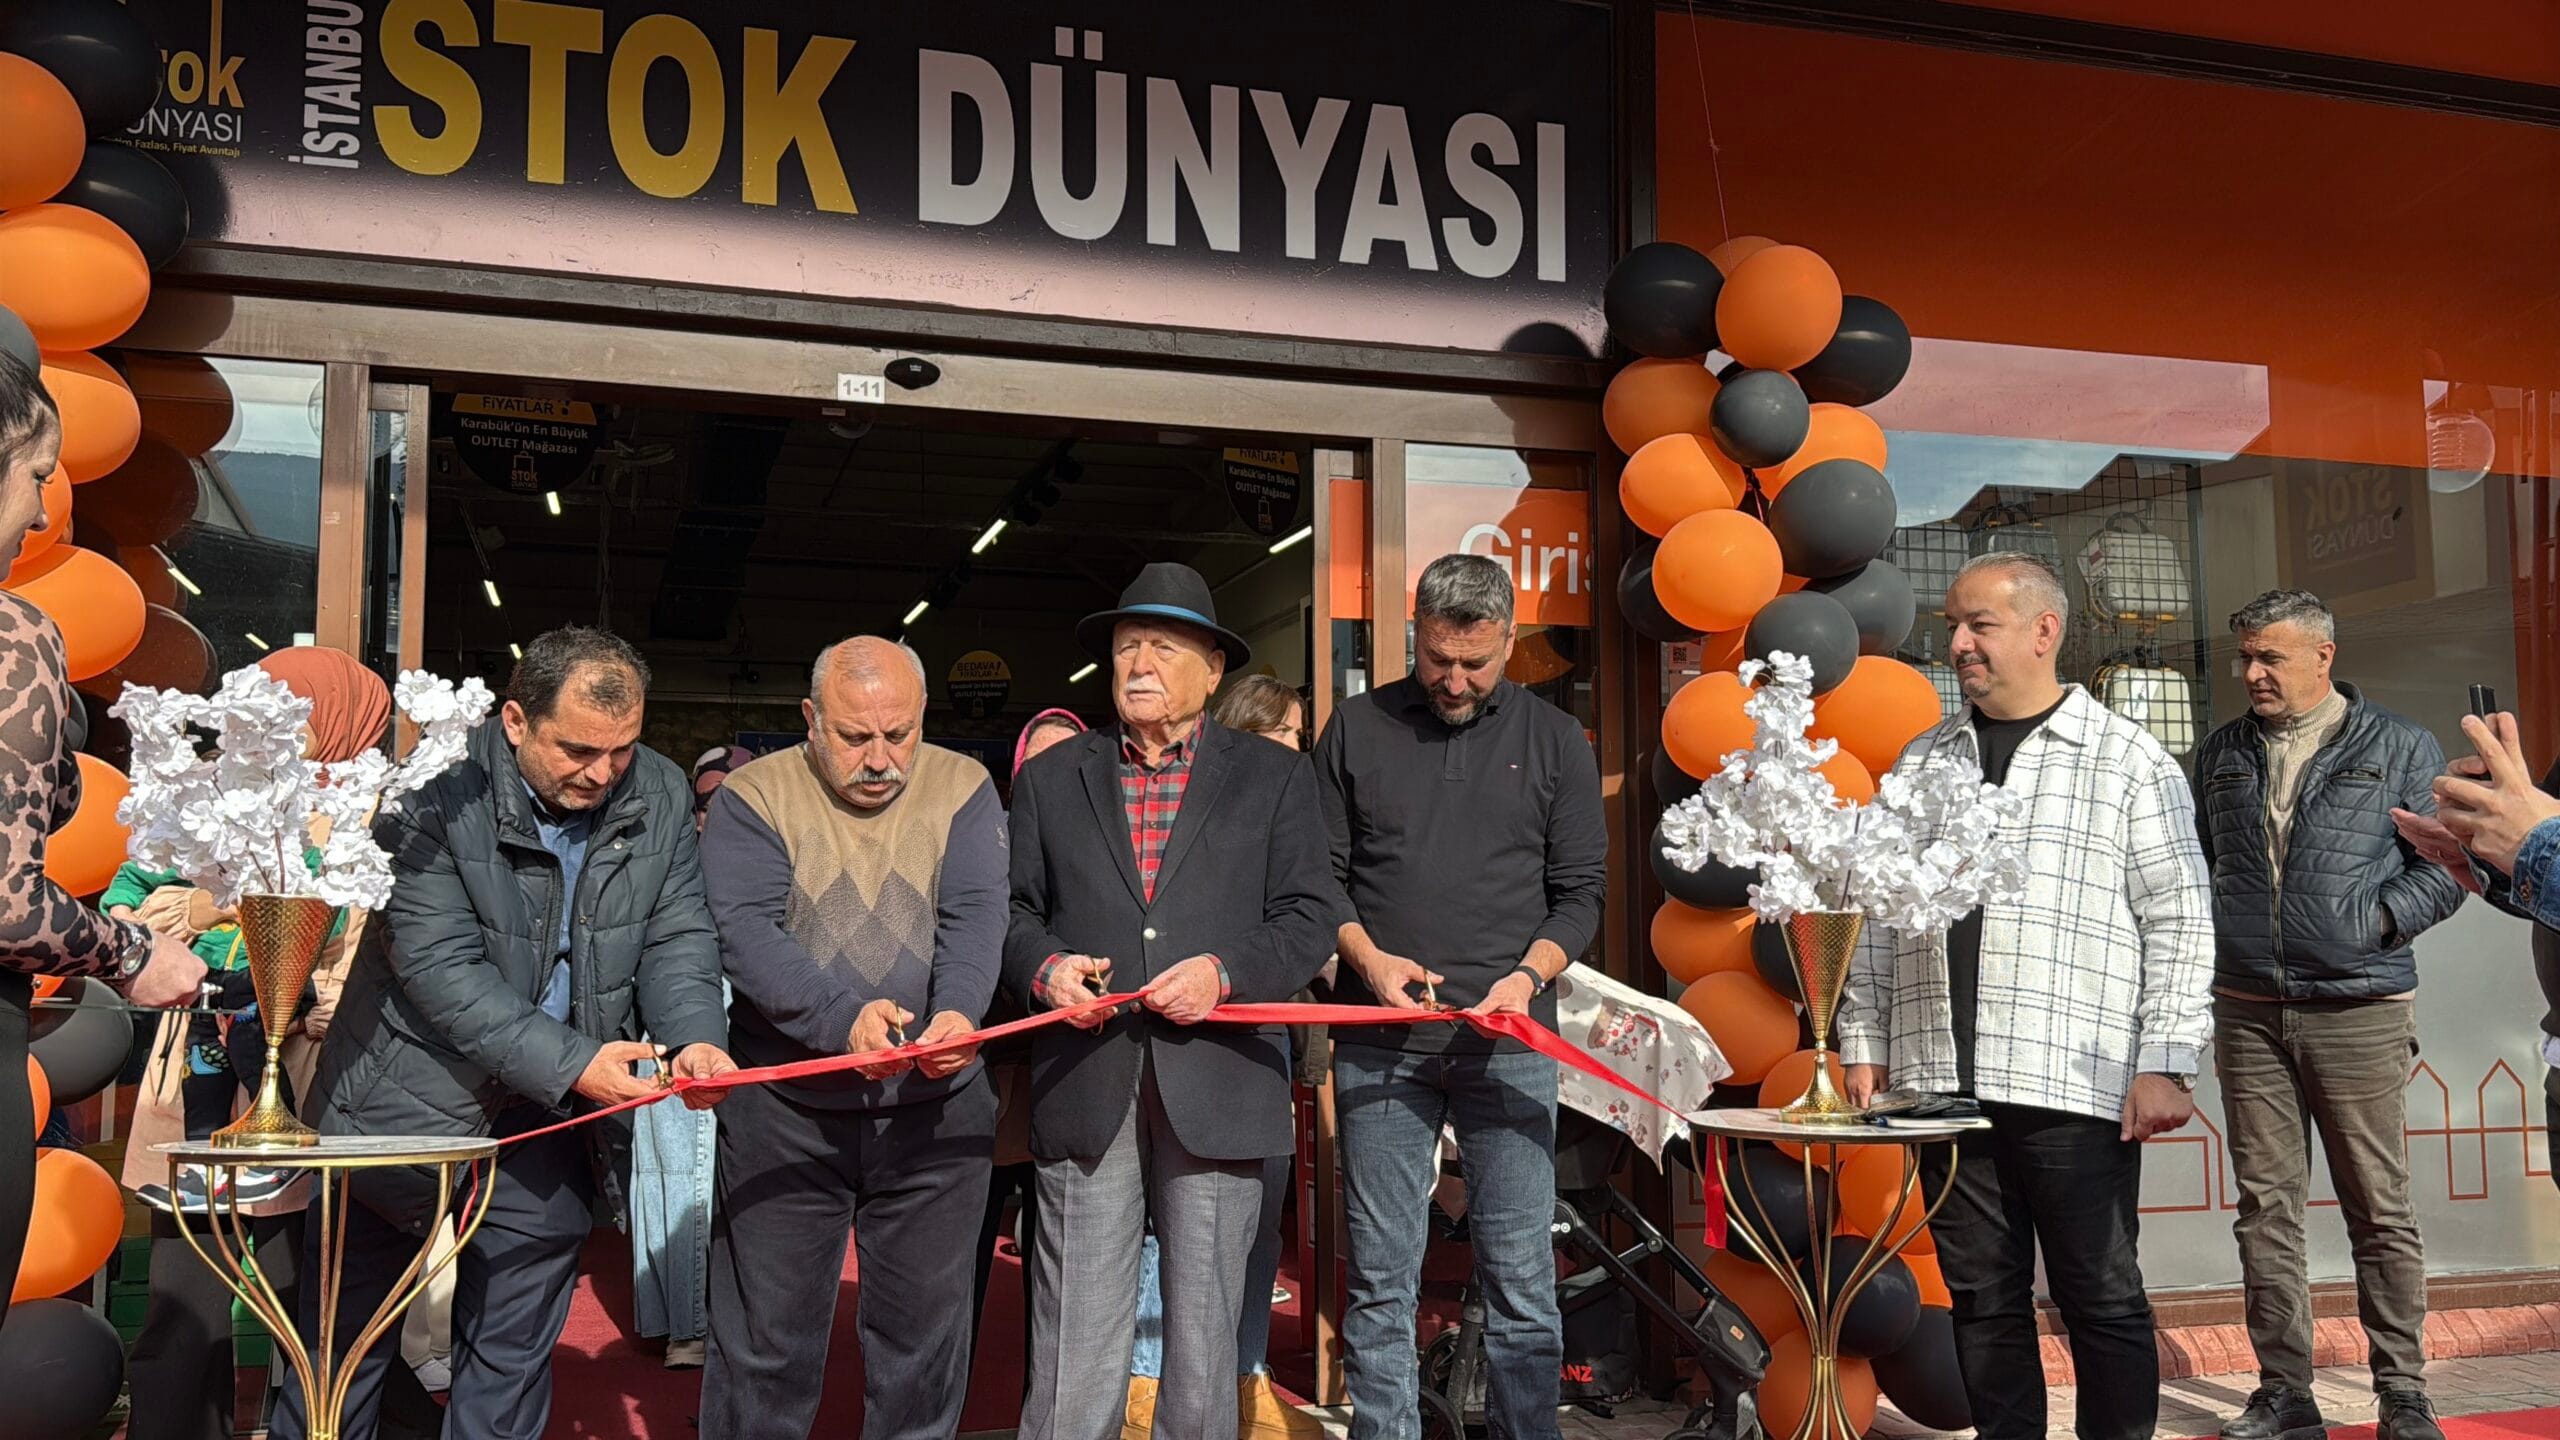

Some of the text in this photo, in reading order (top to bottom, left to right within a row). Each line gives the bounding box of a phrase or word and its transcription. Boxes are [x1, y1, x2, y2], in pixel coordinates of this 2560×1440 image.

[160, 49, 247, 109] OK
[173, 142, 197, 155] Fiyat
[199, 144, 241, 158] Avantajı
[372, 0, 1566, 282] STOK DÜNYASI
[842, 379, 880, 398] 1-11
[461, 417, 589, 440] Karabük'ün En Büyük
[471, 435, 577, 455] OUTLET Mağazası
[511, 470, 538, 482] STOK
